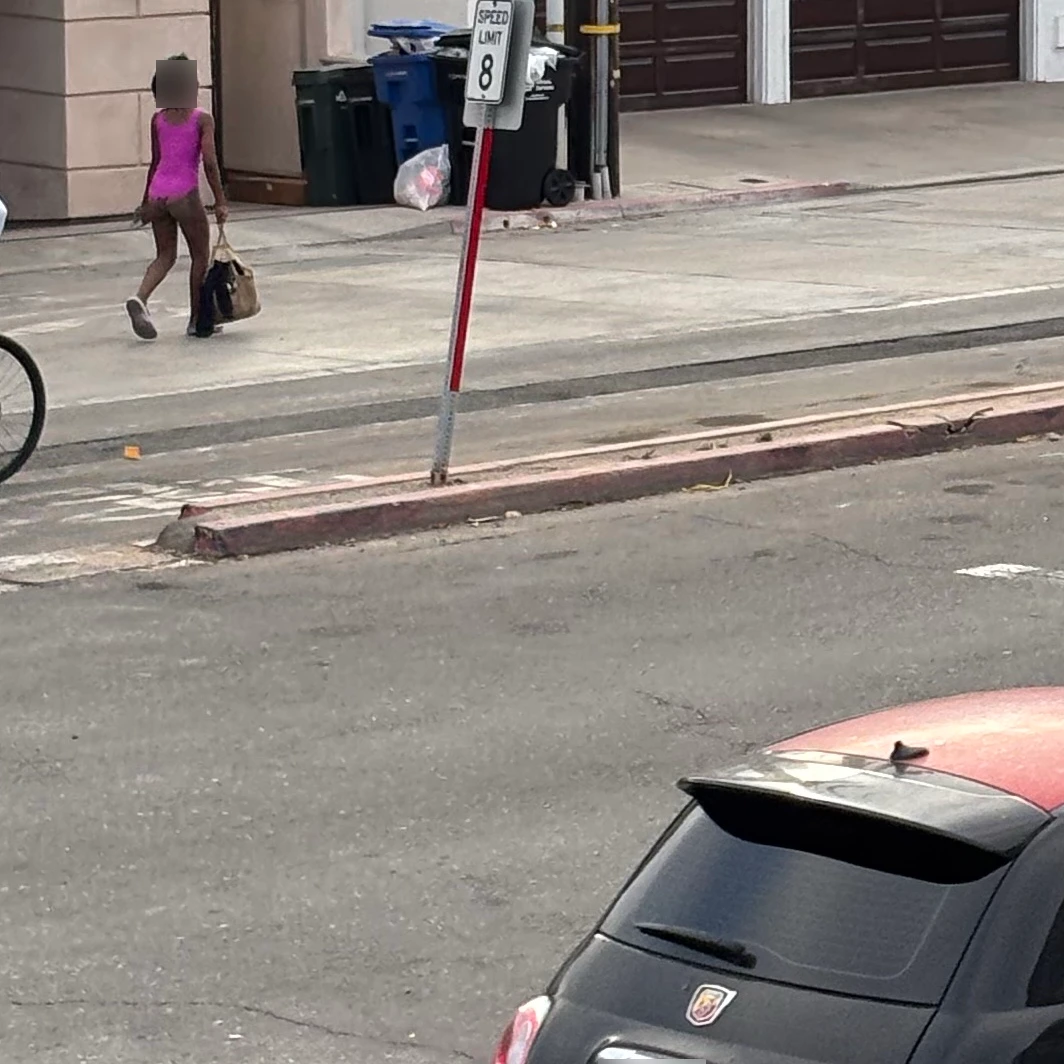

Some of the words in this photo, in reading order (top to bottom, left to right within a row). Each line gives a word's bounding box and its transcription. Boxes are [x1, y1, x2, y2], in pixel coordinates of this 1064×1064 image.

[478, 9, 509, 25] SPEED
[478, 30, 502, 45] LIMIT
[479, 53, 493, 91] 8
